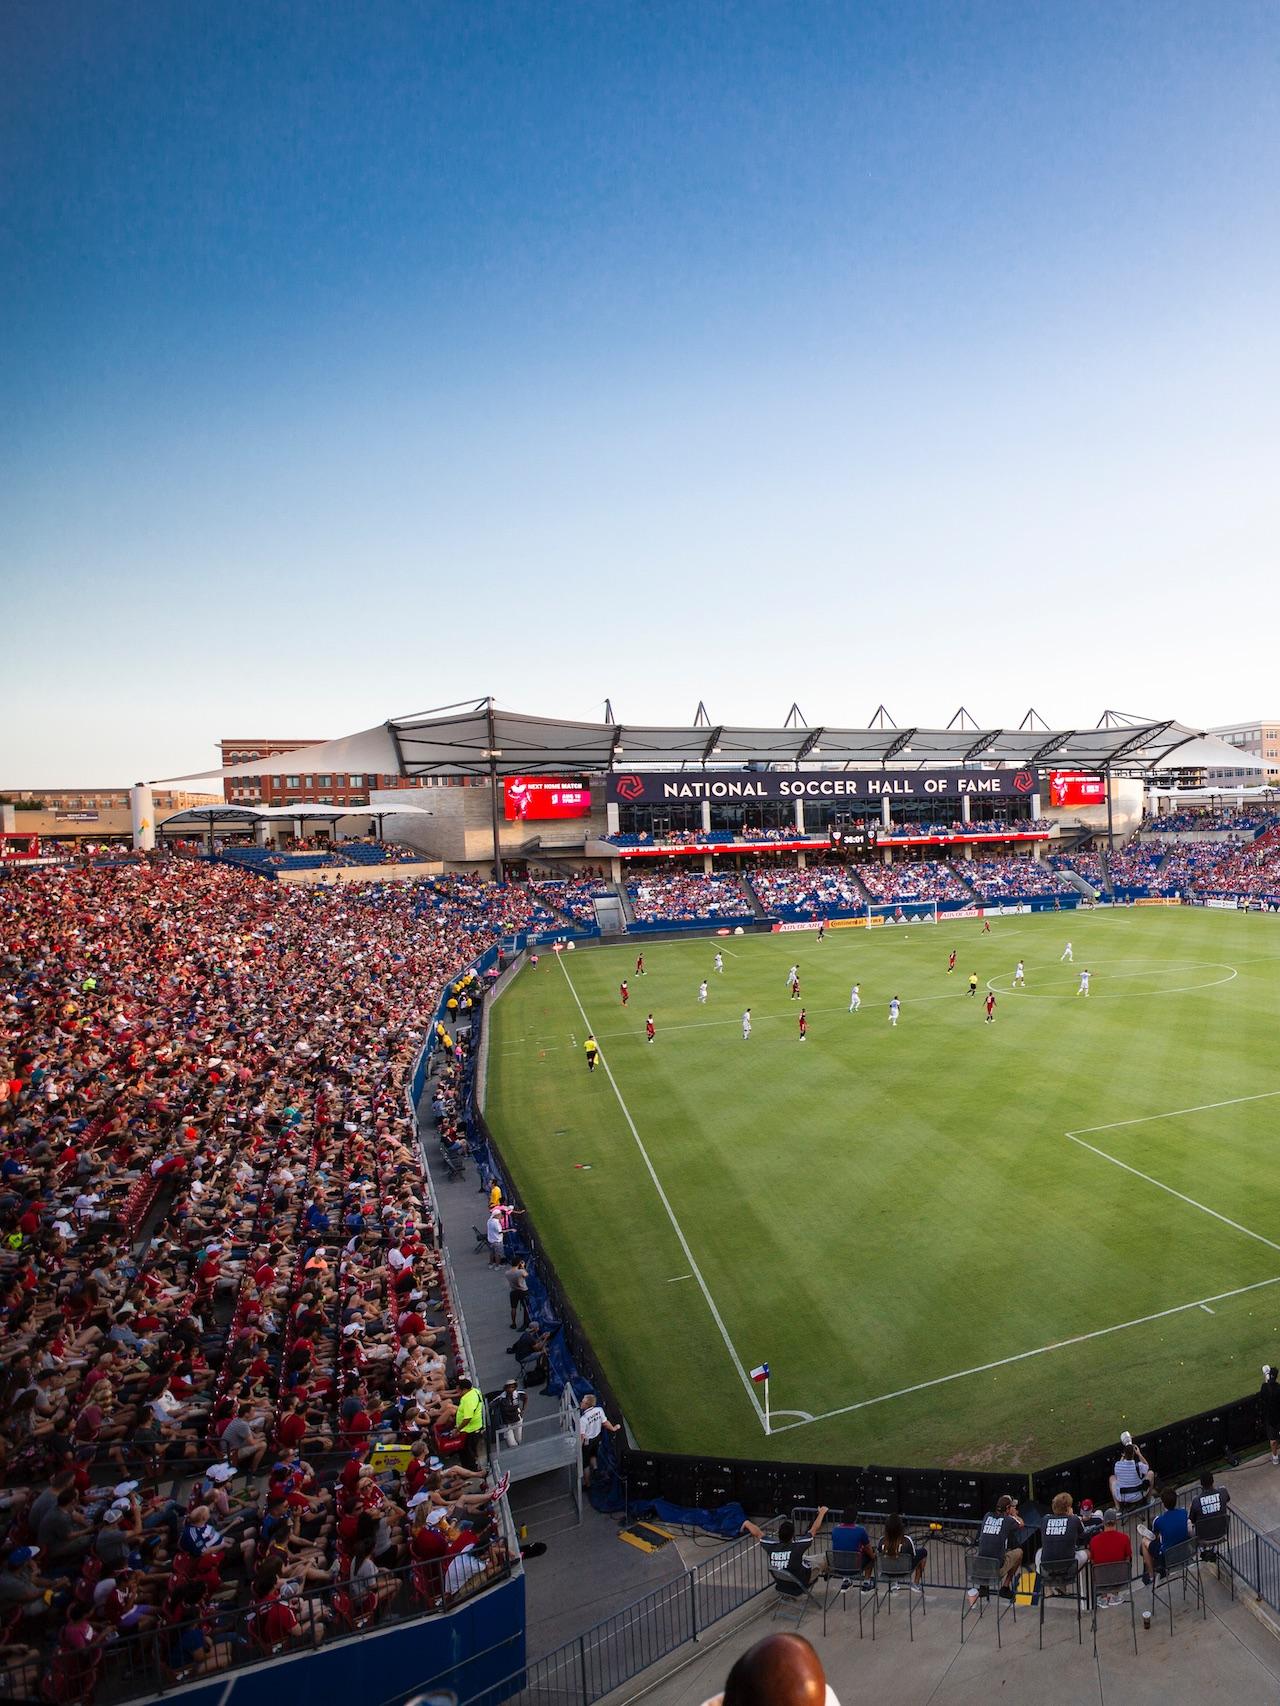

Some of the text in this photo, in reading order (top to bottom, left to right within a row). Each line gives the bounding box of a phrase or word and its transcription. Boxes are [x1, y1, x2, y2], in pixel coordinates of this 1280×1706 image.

[664, 778, 1000, 798] NATIONAL SOCCER HALL OF FAME
[1200, 1493, 1220, 1505] EVENT
[1202, 1503, 1221, 1515] STAFF
[985, 1515, 1004, 1526] EVENT
[1047, 1518, 1068, 1527] EVENT
[983, 1525, 1001, 1535] STAFF
[1046, 1526, 1067, 1536] STAFF
[771, 1551, 791, 1562] EVENT
[771, 1560, 790, 1570] STAFF
